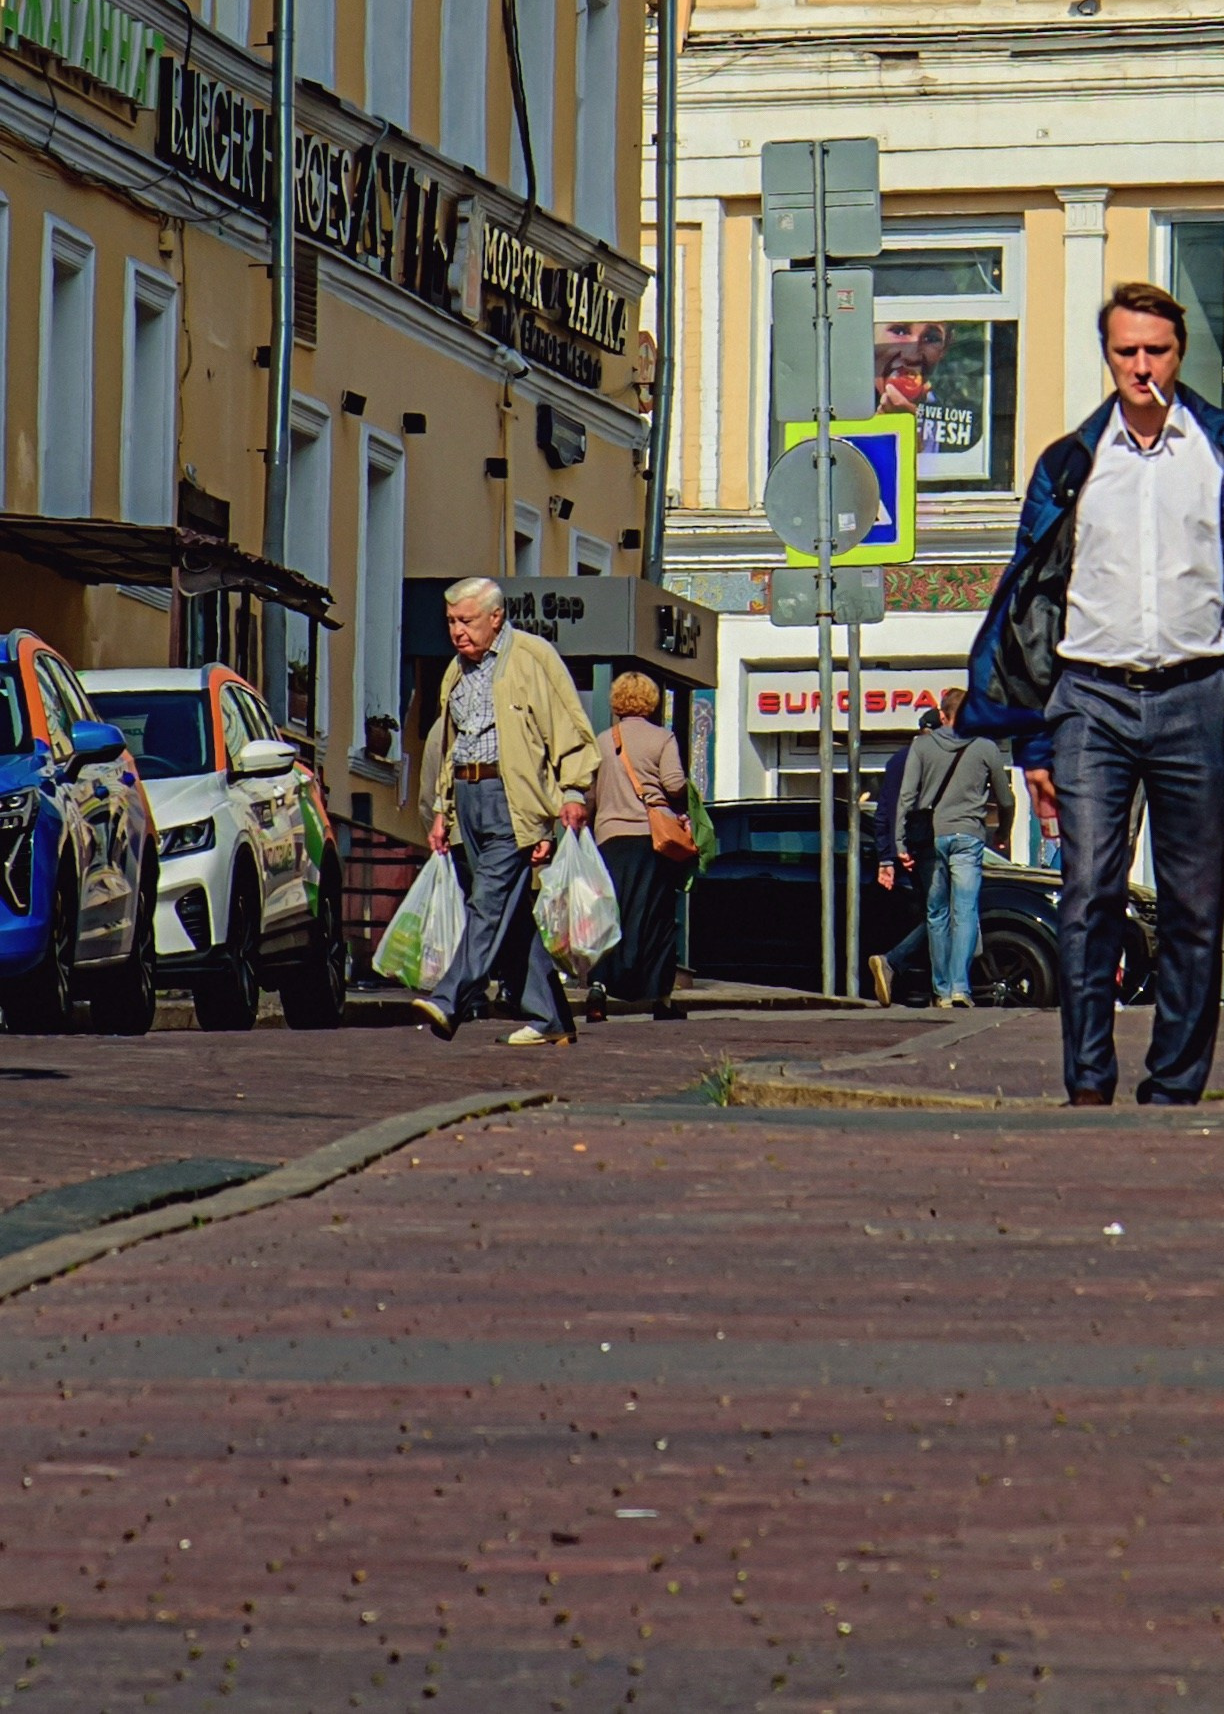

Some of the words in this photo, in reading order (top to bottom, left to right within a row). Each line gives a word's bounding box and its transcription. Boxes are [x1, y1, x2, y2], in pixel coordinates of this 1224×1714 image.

[171, 57, 254, 198] BURGER
[261, 109, 351, 246] HROES
[483, 222, 545, 310] МОРЯК
[566, 262, 629, 352] ЧАЙКА
[916, 403, 943, 419] #WE
[944, 407, 973, 423] LOVE
[541, 591, 585, 624] бар
